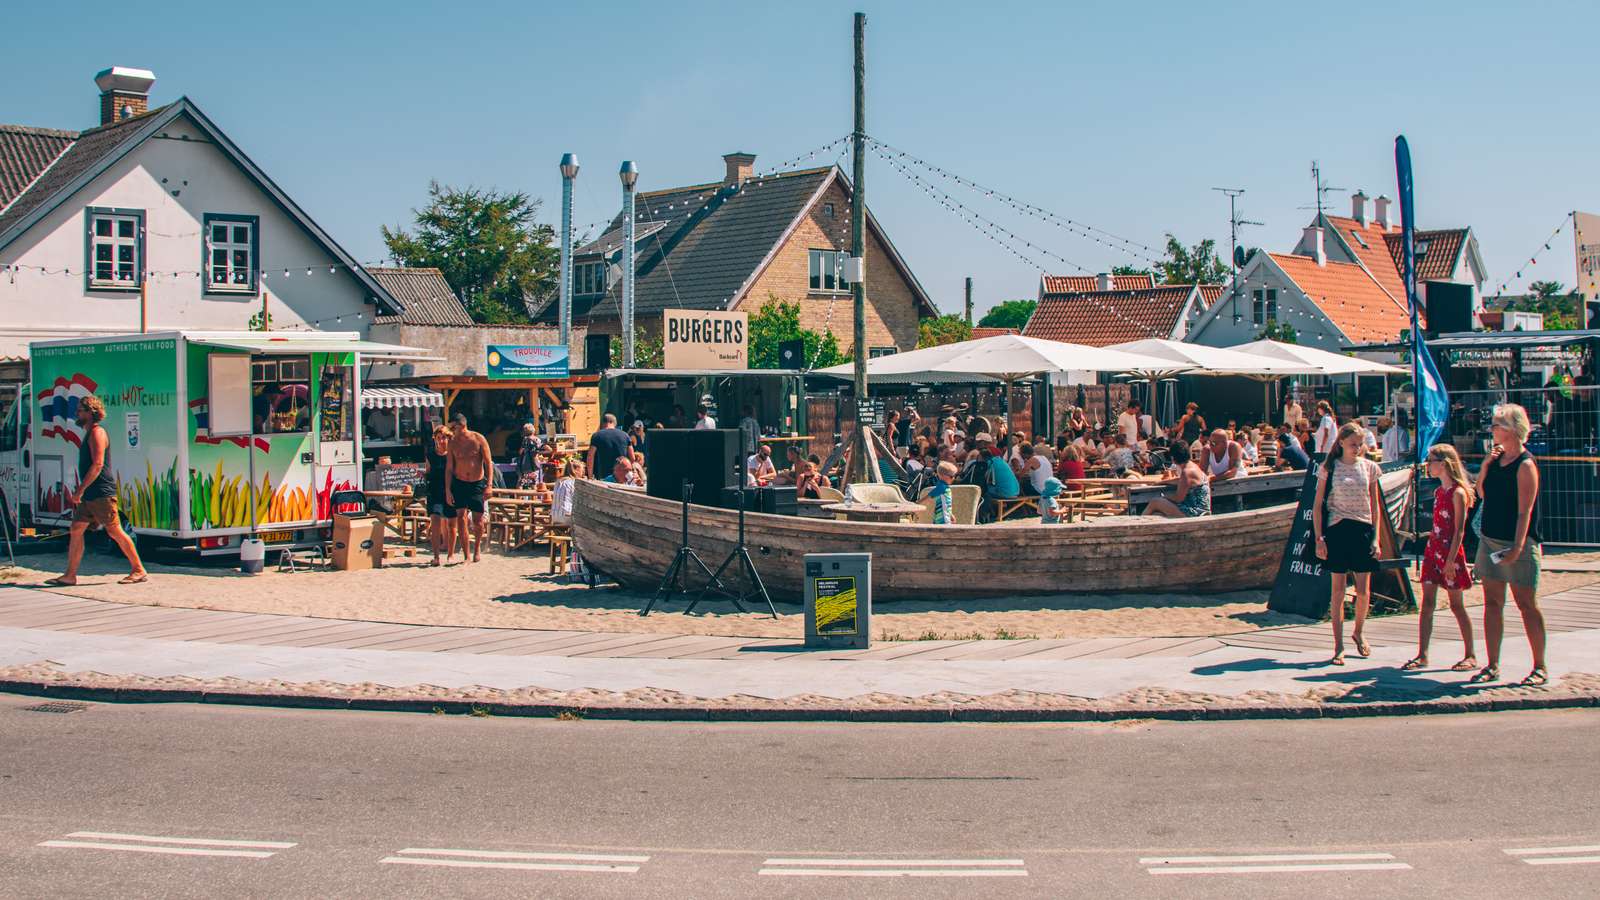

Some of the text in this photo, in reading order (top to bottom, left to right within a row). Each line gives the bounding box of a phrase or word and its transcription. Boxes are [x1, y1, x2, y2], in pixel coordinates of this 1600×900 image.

[669, 318, 743, 344] BURGERS
[64, 347, 78, 356] THAI
[80, 346, 95, 354] FOOD
[105, 341, 175, 353] AUTHENTIC THAI FOOD
